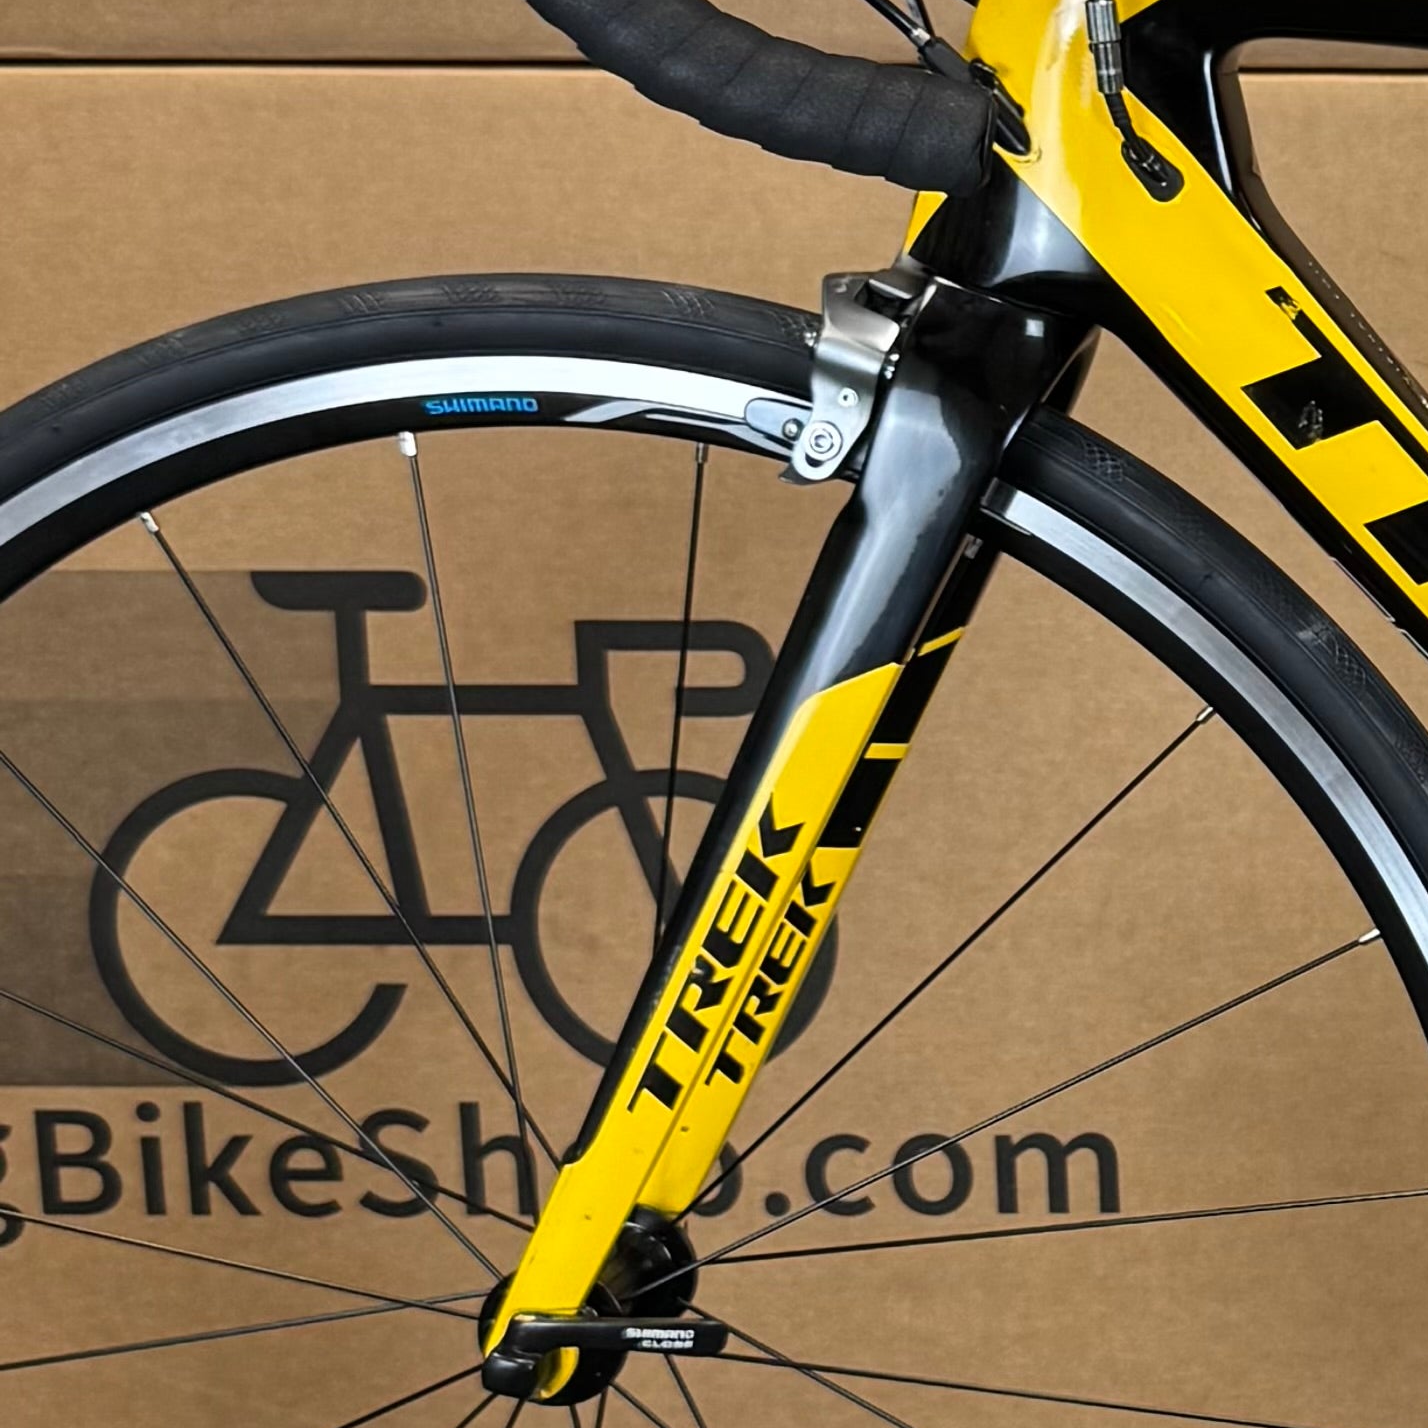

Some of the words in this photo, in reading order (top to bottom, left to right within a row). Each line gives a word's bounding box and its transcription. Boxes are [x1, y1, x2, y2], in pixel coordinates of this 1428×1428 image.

[424, 396, 539, 416] SHIMANO
[627, 792, 806, 1114] TREK
[705, 858, 836, 1087] TREK
